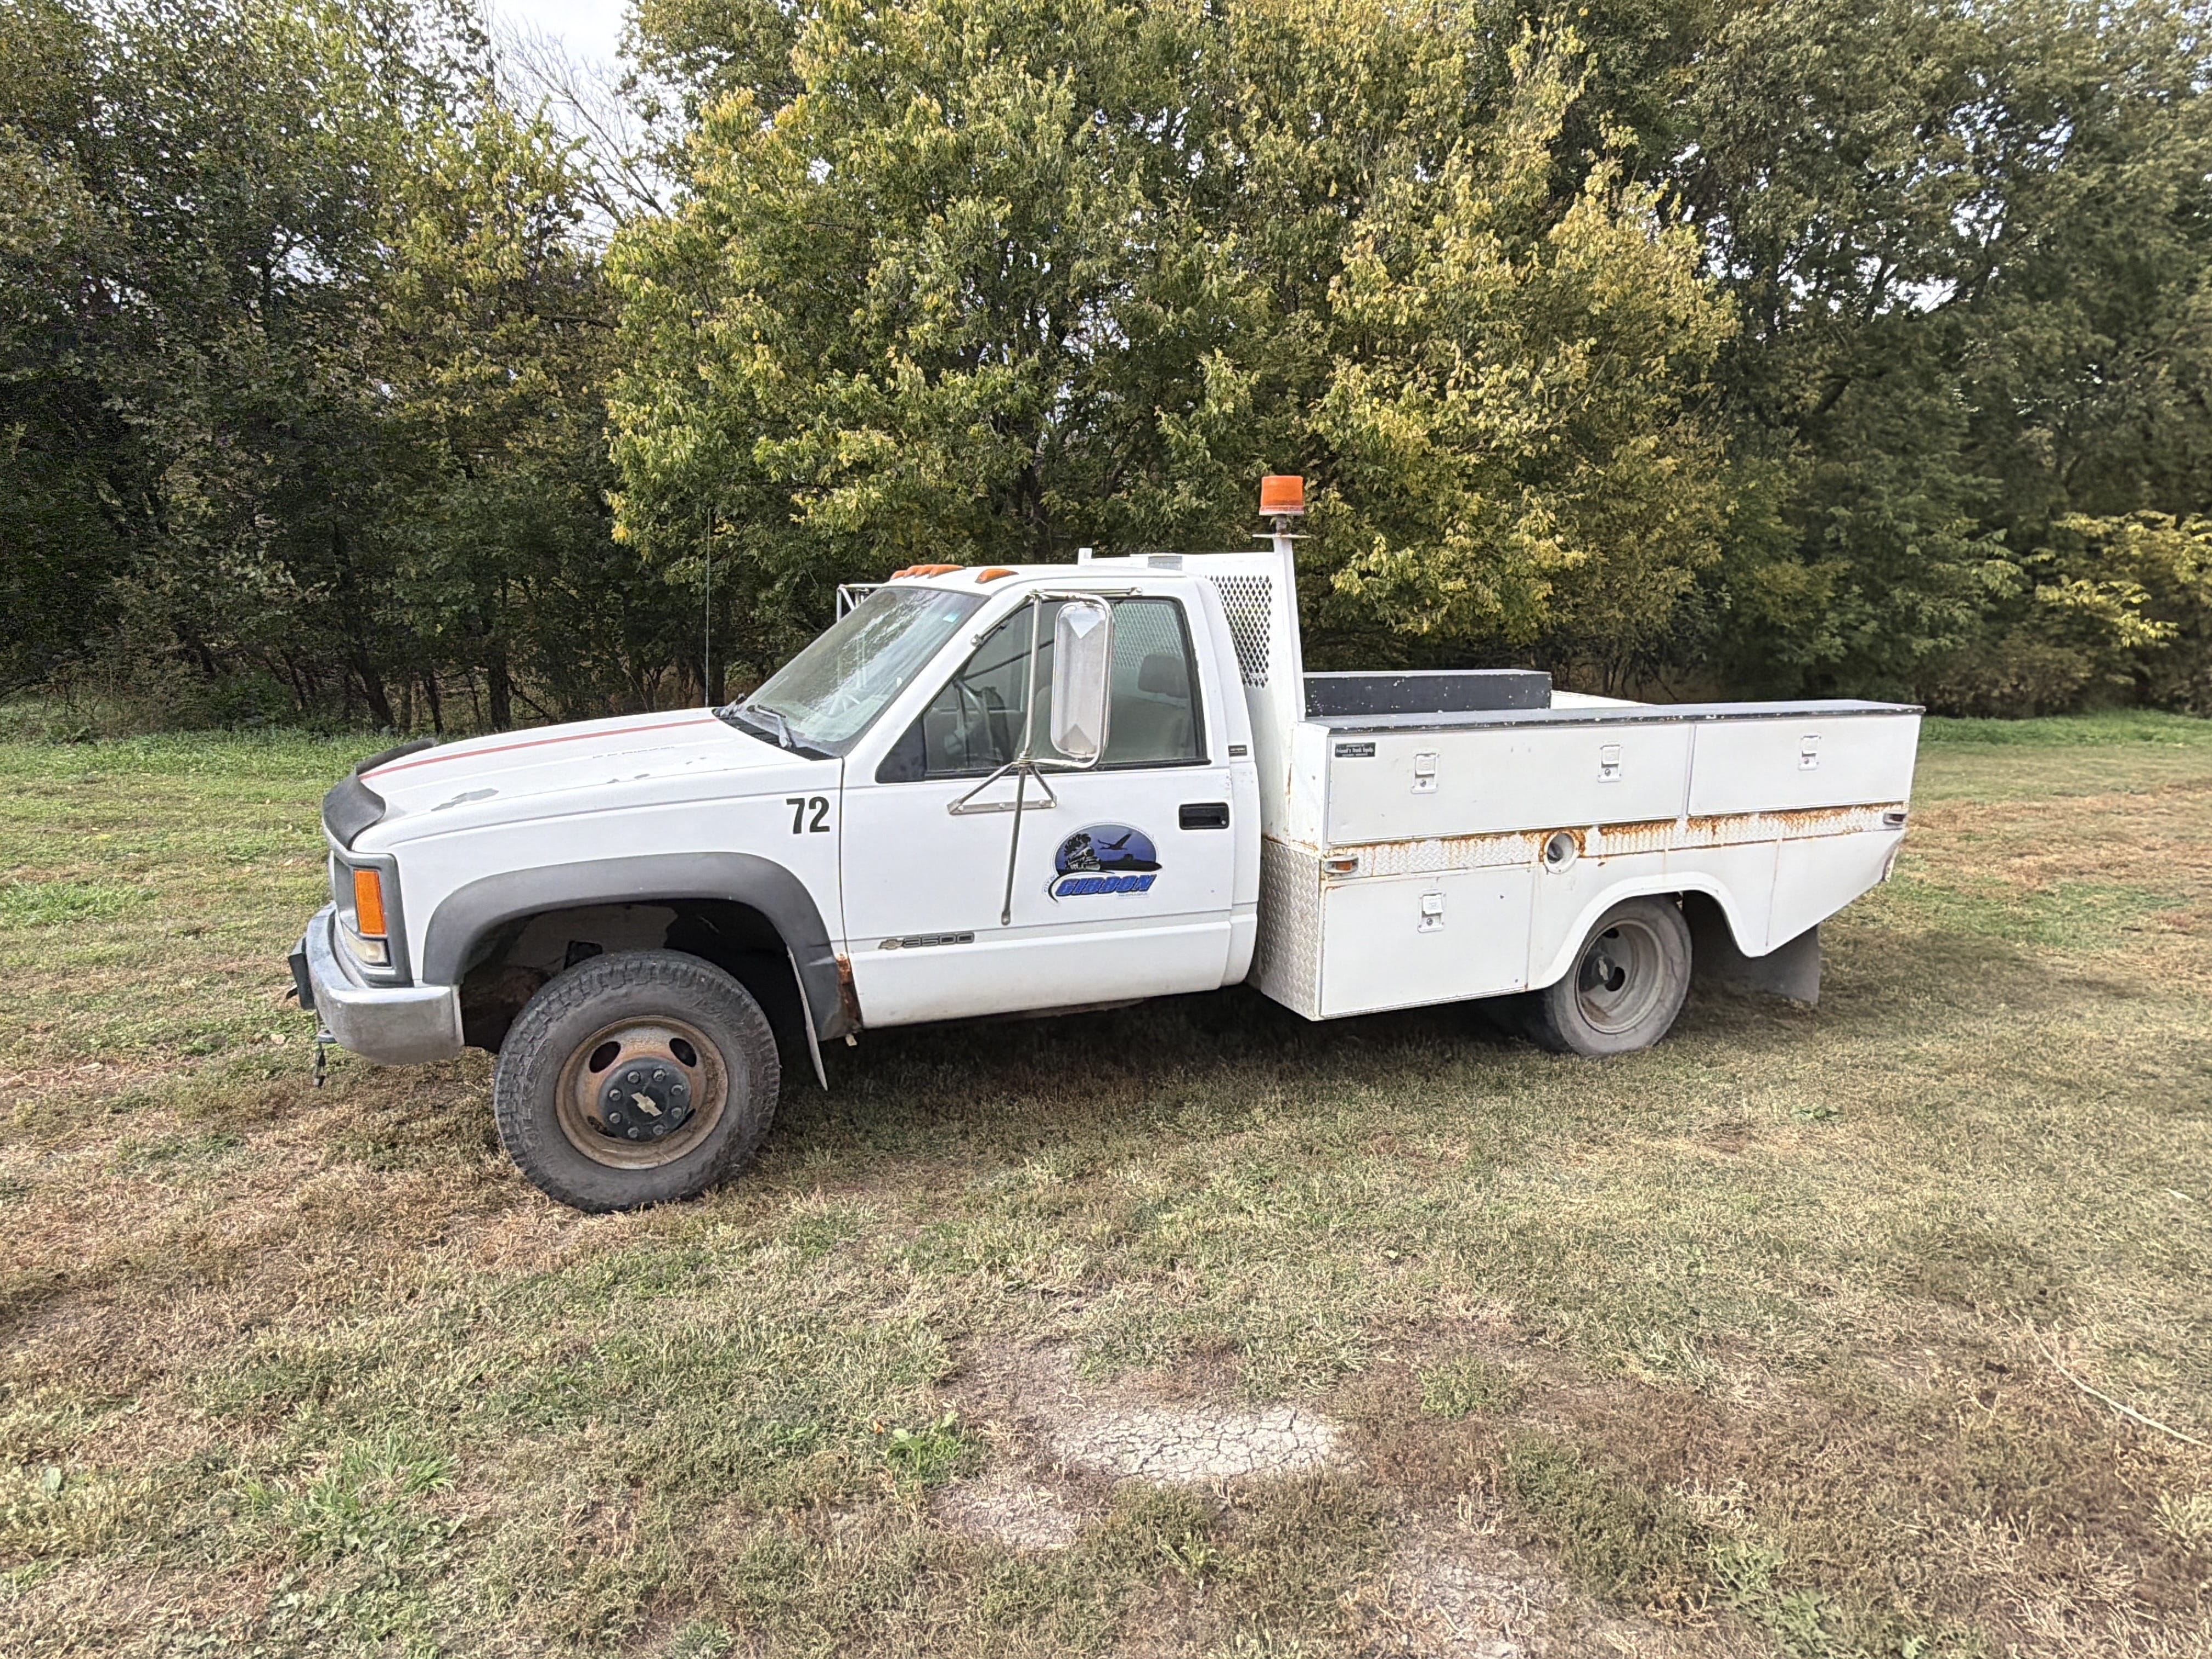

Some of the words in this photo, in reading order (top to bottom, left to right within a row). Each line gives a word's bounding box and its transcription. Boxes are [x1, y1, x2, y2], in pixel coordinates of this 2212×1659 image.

[786, 796, 830, 834] 72
[1055, 874, 1158, 897] GIBBON
[903, 932, 975, 949] 3500
